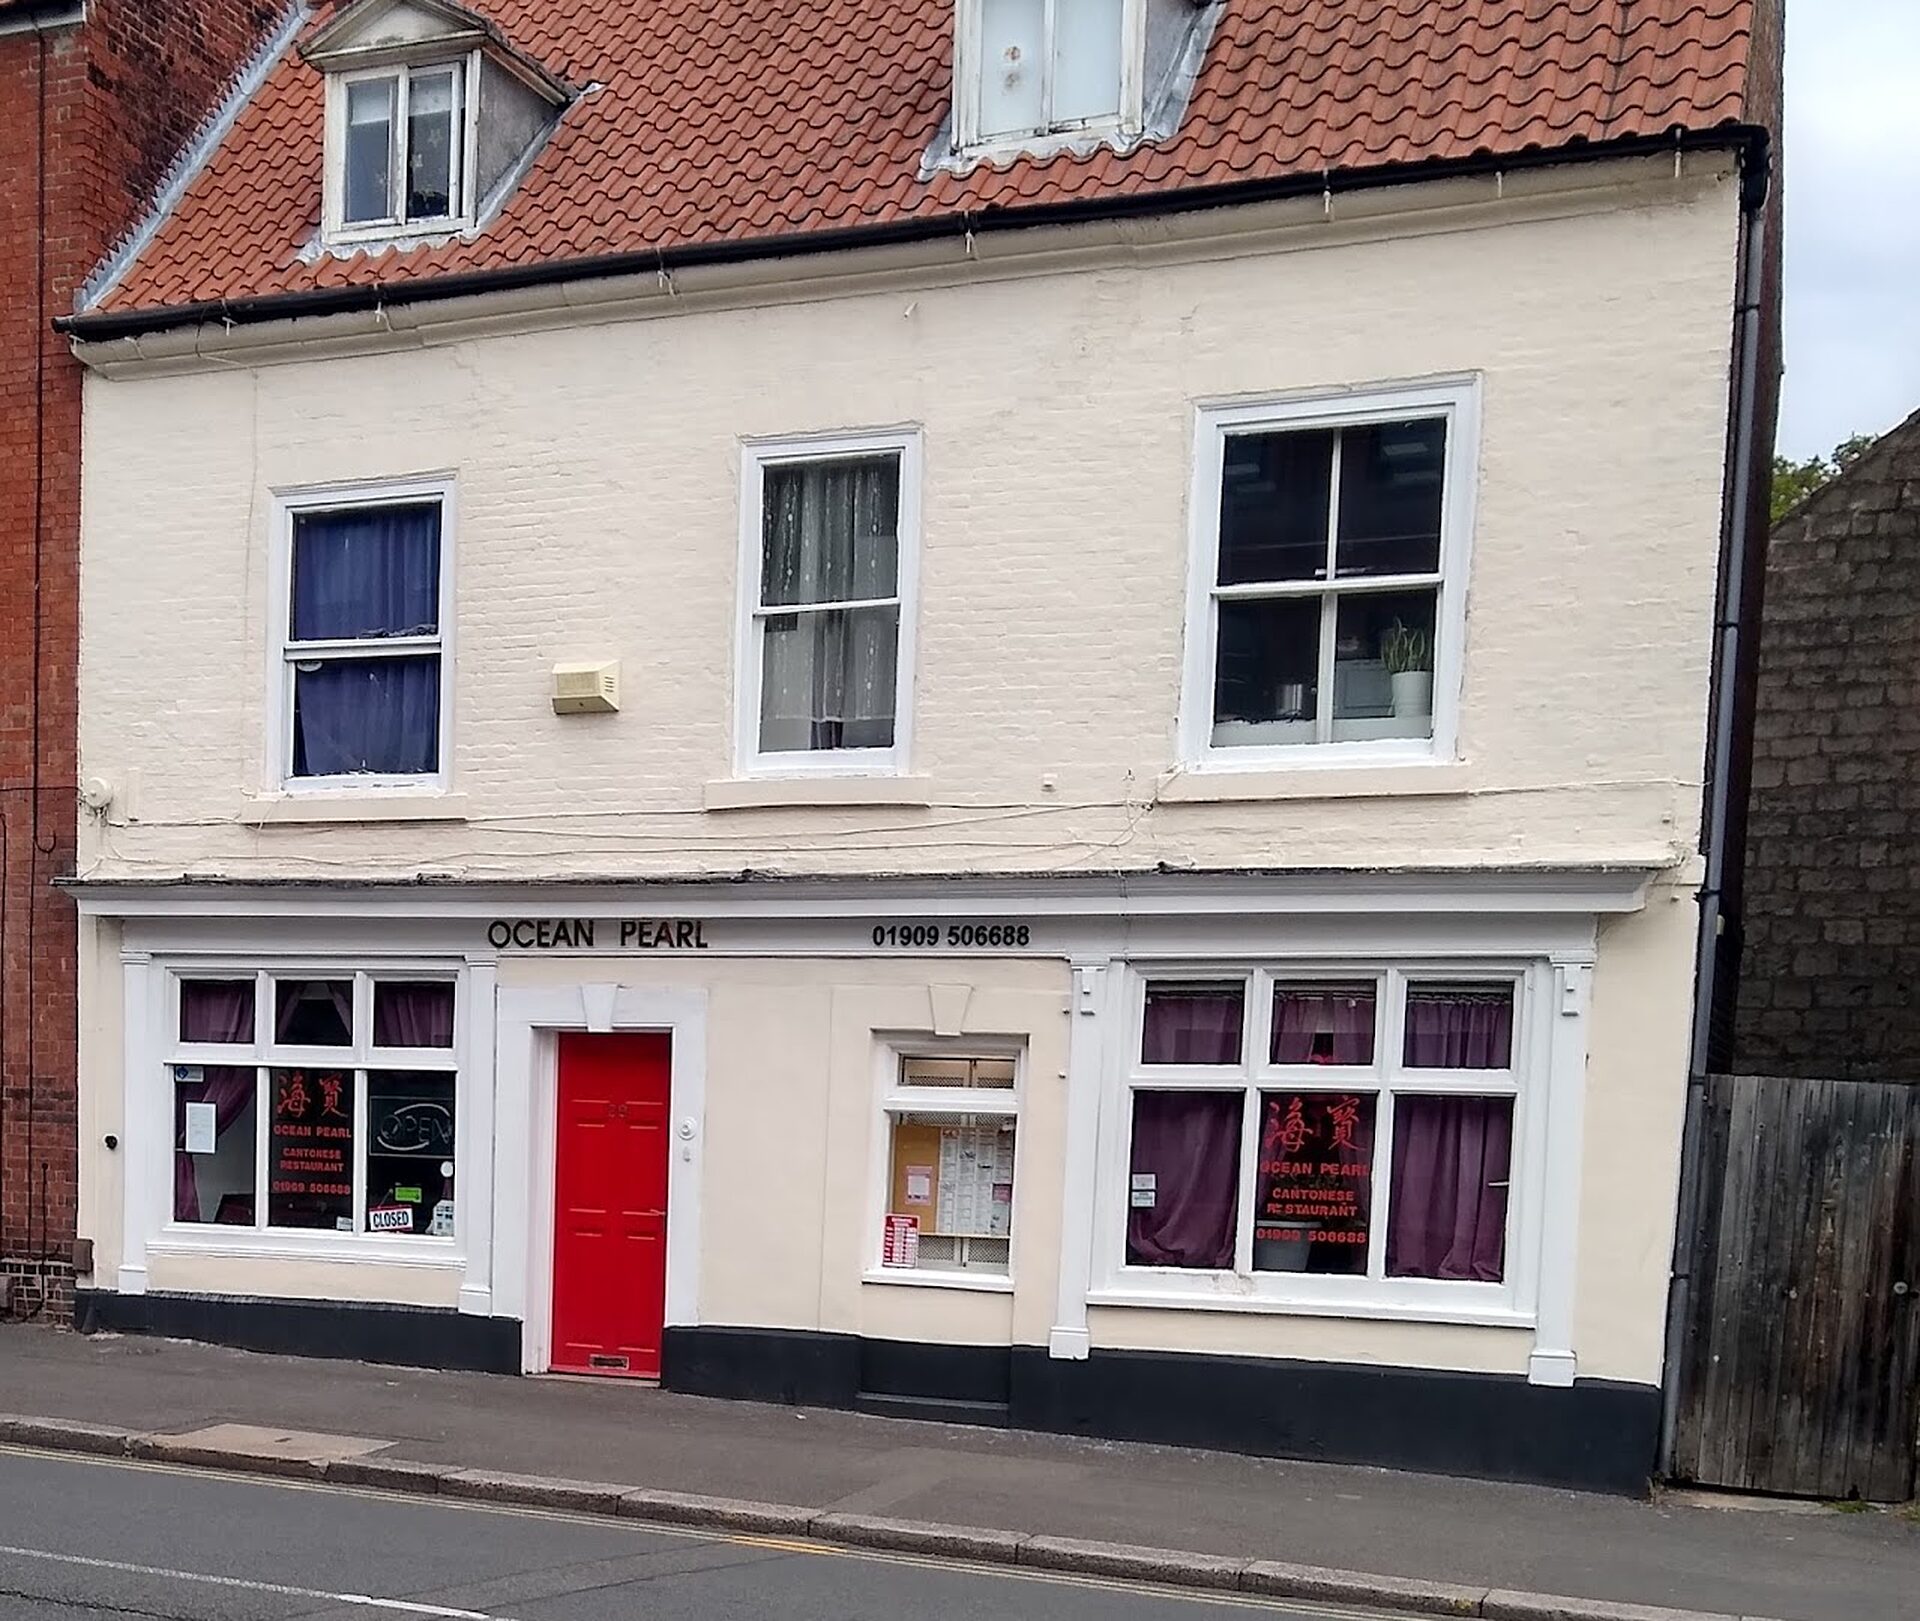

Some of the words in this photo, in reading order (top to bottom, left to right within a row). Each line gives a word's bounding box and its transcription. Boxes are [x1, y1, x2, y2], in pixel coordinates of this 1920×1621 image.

[487, 919, 594, 948] OCEAN
[620, 920, 708, 948] PEARL
[872, 925, 939, 946] 01909
[947, 925, 1030, 946] 506688
[273, 1124, 311, 1137] OCEAN
[316, 1126, 352, 1139] PEARL
[380, 1113, 453, 1144] OPEN
[283, 1147, 342, 1160] CANTONESE
[279, 1160, 345, 1173] RESTAURANT
[1260, 1161, 1313, 1175] OCEAN
[1272, 1187, 1356, 1202] CANTONESE
[1266, 1202, 1359, 1217] RESTAURANT
[372, 1210, 411, 1228] CLOSED
[1307, 1229, 1367, 1244] 506688
